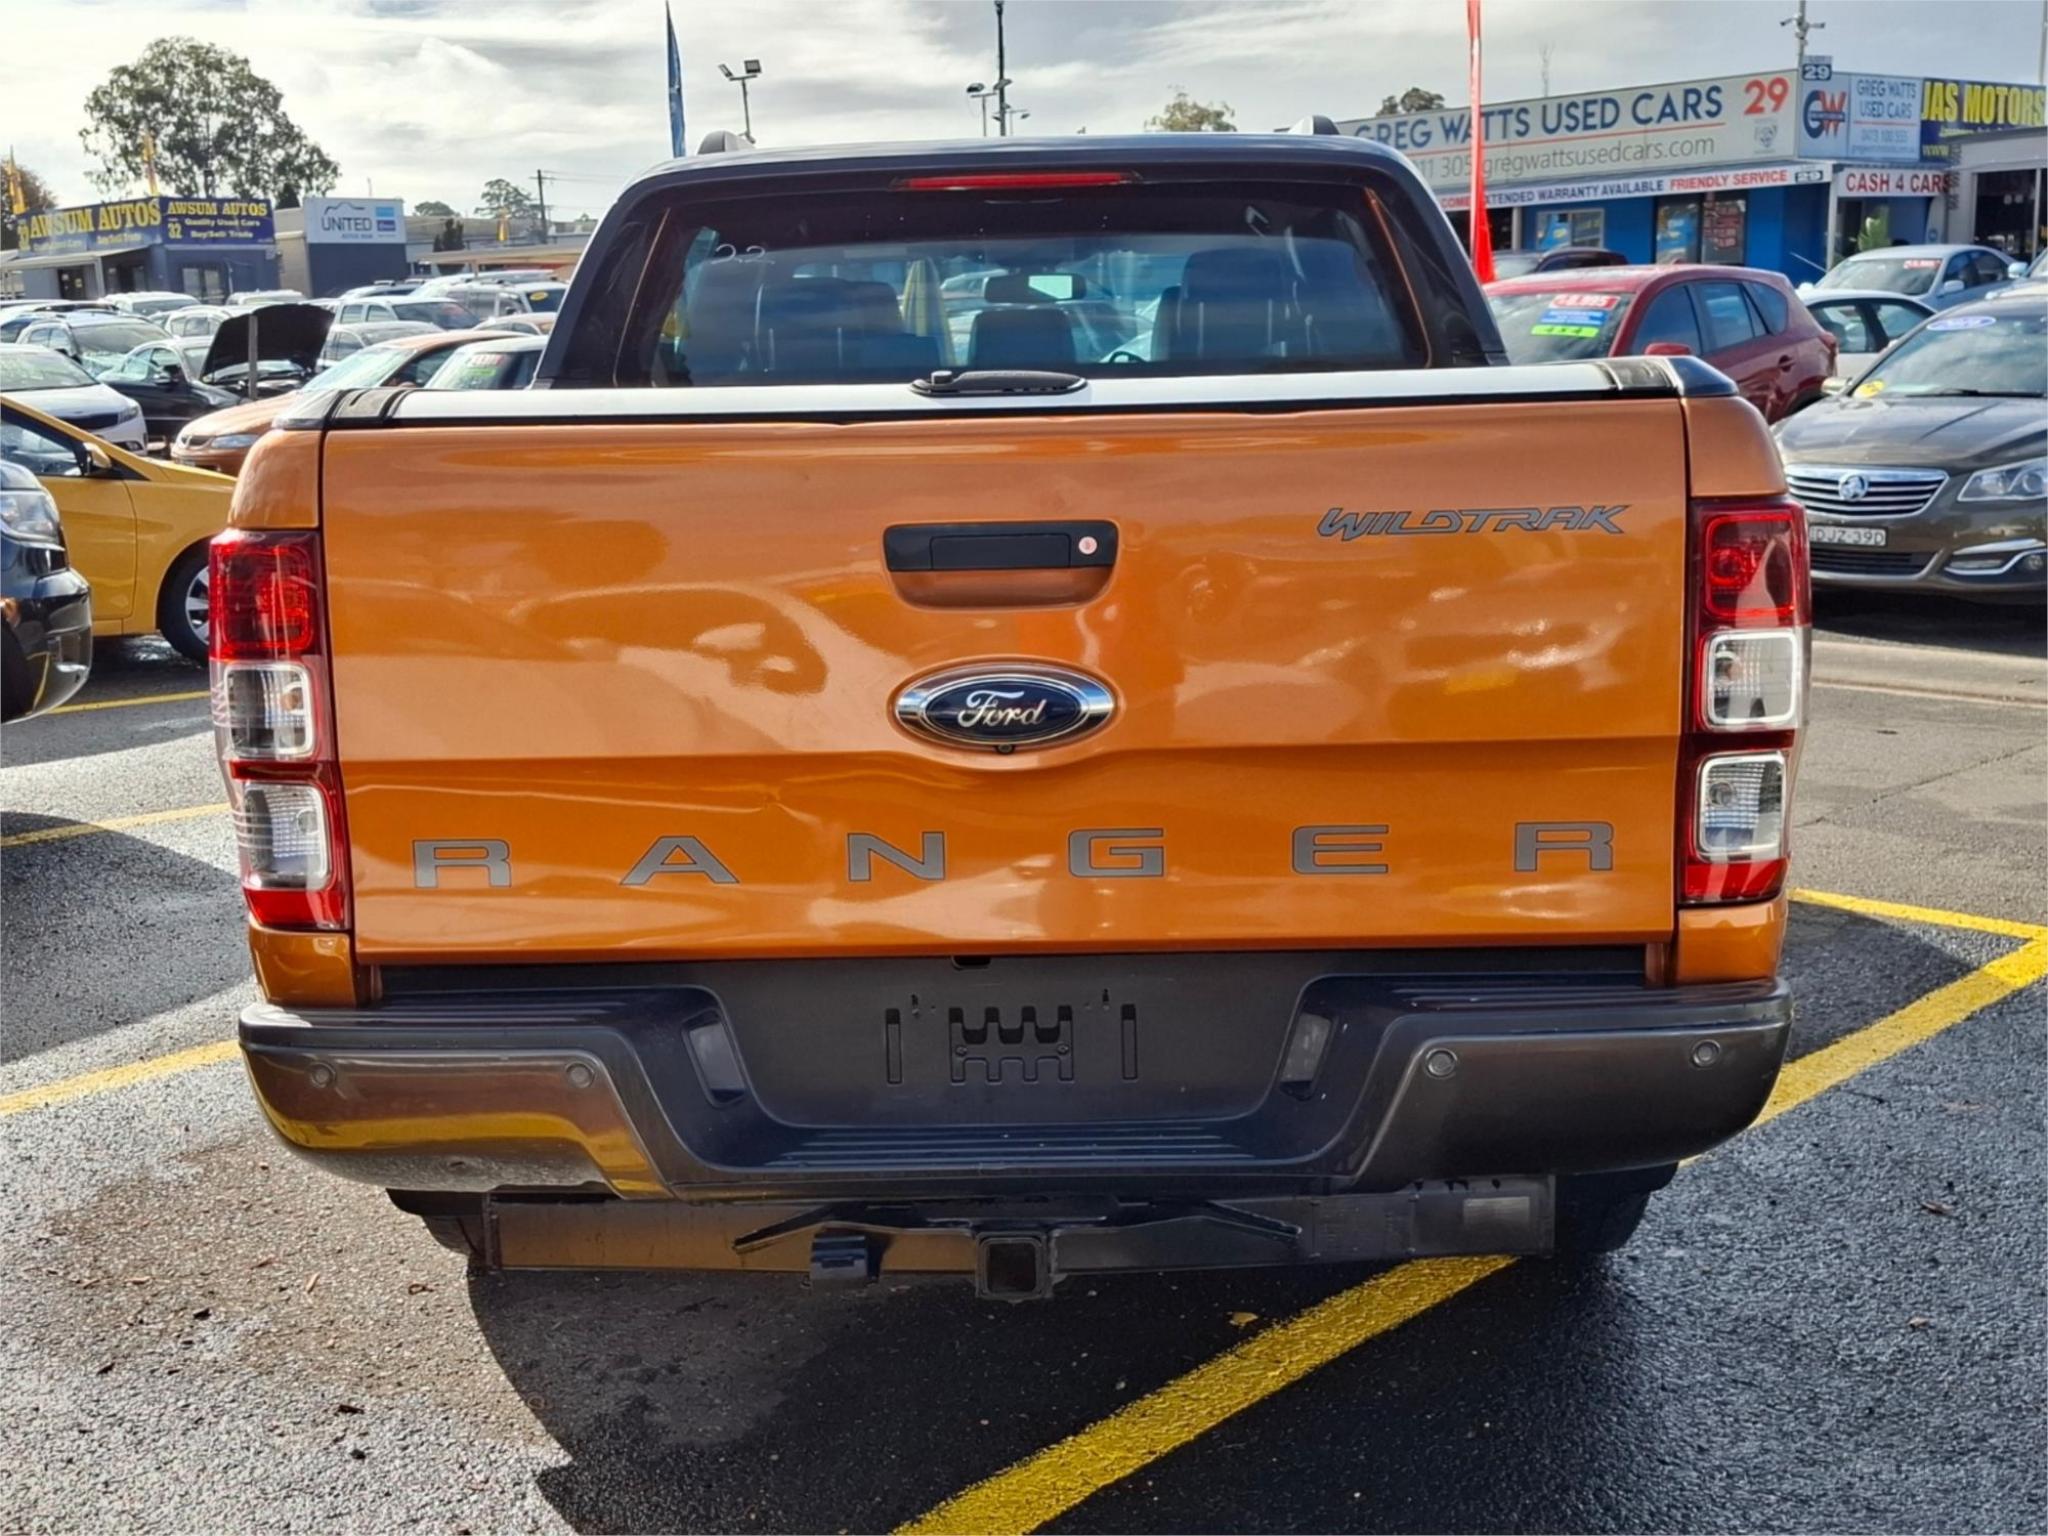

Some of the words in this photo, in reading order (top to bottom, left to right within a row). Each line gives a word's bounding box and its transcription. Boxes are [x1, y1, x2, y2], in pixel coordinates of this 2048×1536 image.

[1804, 65, 1830, 80] 29
[1856, 80, 1885, 97] GREG
[1888, 82, 1917, 99] WATTS
[1541, 97, 1620, 134] USED
[1631, 85, 1723, 125] CARS
[1744, 77, 1789, 115] 29
[1860, 101, 1884, 117] USED
[1887, 103, 1912, 119] CARS
[1921, 82, 1958, 121] JAS
[1963, 84, 2045, 127] MOTORS
[1483, 137, 1715, 179] gregwattsusedcars.com
[1538, 185, 1598, 201] WARRANTY
[1601, 180, 1664, 197] AVAILABLE
[1670, 174, 1731, 190] FRIENDLY
[1733, 170, 1788, 186] SERVICE
[1846, 173, 1890, 192] CASH
[1895, 174, 1904, 191] 4
[1910, 174, 1951, 192] CARS
[30, 208, 94, 238] AWSUM
[98, 198, 161, 231] AUTOS
[168, 202, 217, 215] AWSUM
[223, 203, 268, 216] AUTOS
[321, 217, 373, 231] UNITED
[168, 223, 182, 239] 32
[1317, 504, 1632, 541] WILDTRAK
[957, 689, 1047, 728] Ford
[412, 821, 1614, 889] RANGER
